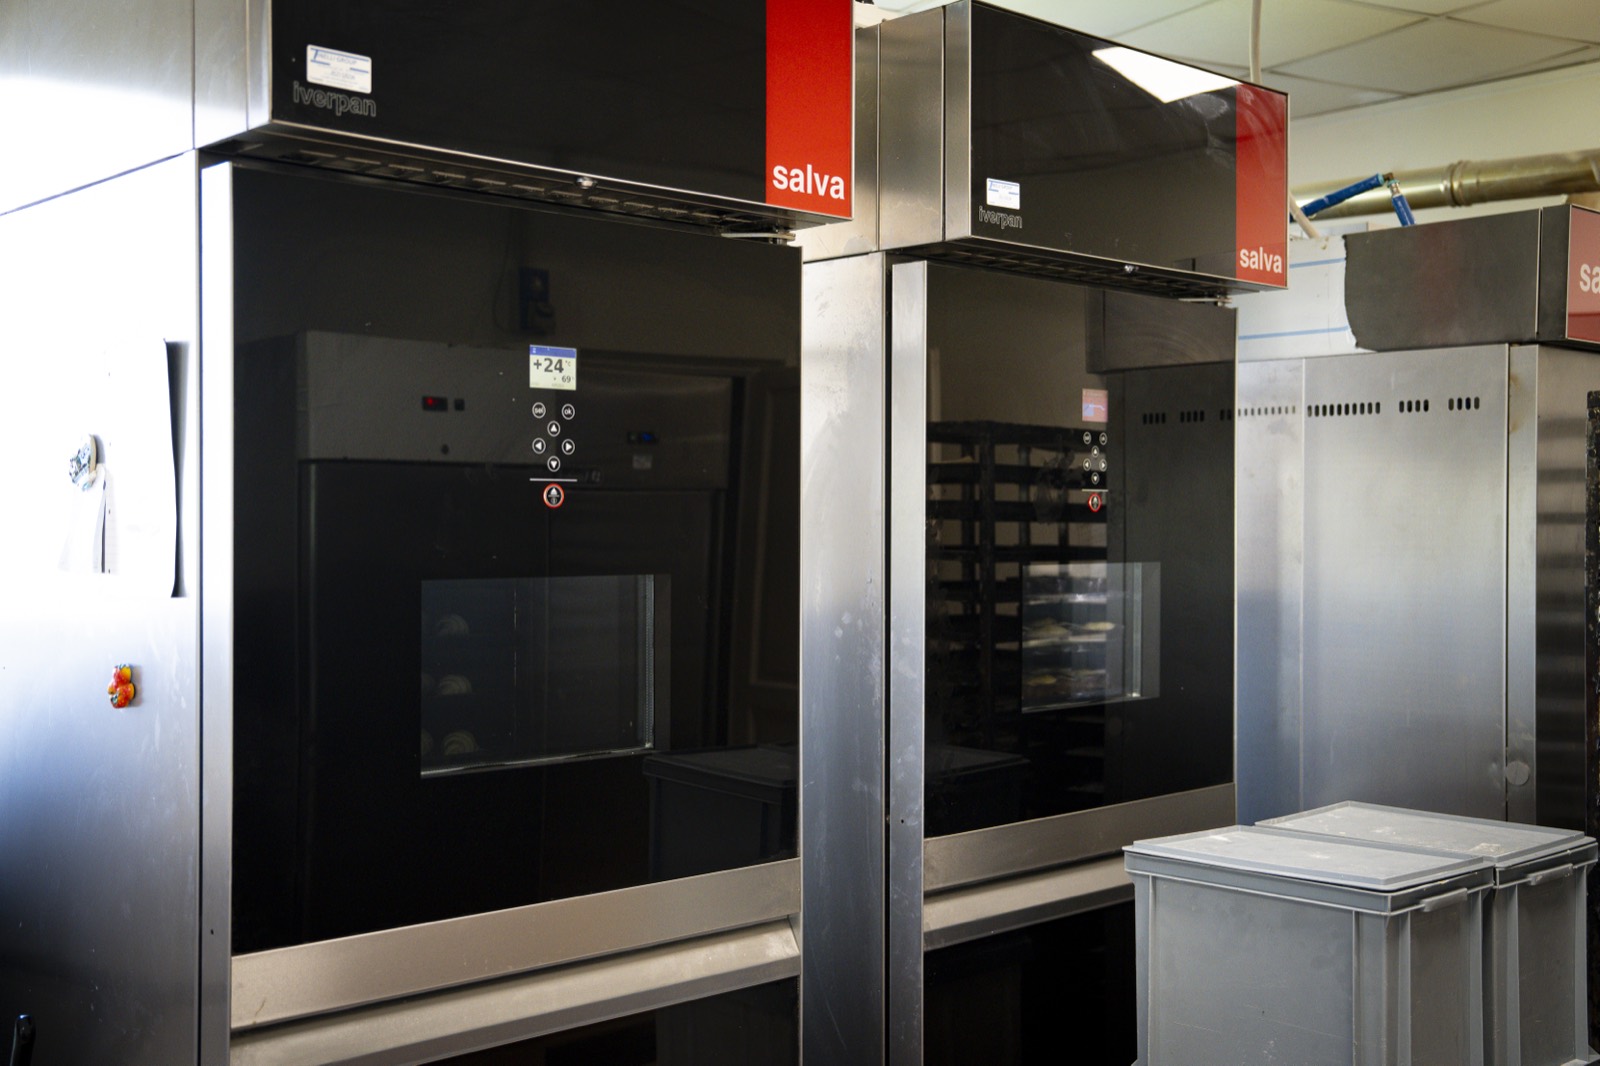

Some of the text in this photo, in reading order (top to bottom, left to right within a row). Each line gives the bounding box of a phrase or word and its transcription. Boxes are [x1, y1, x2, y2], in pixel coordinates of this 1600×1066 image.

[293, 80, 377, 117] iverpan
[772, 163, 845, 200] salva
[978, 205, 1023, 230] iverpan
[1239, 246, 1283, 274] salva
[533, 357, 565, 373] +24
